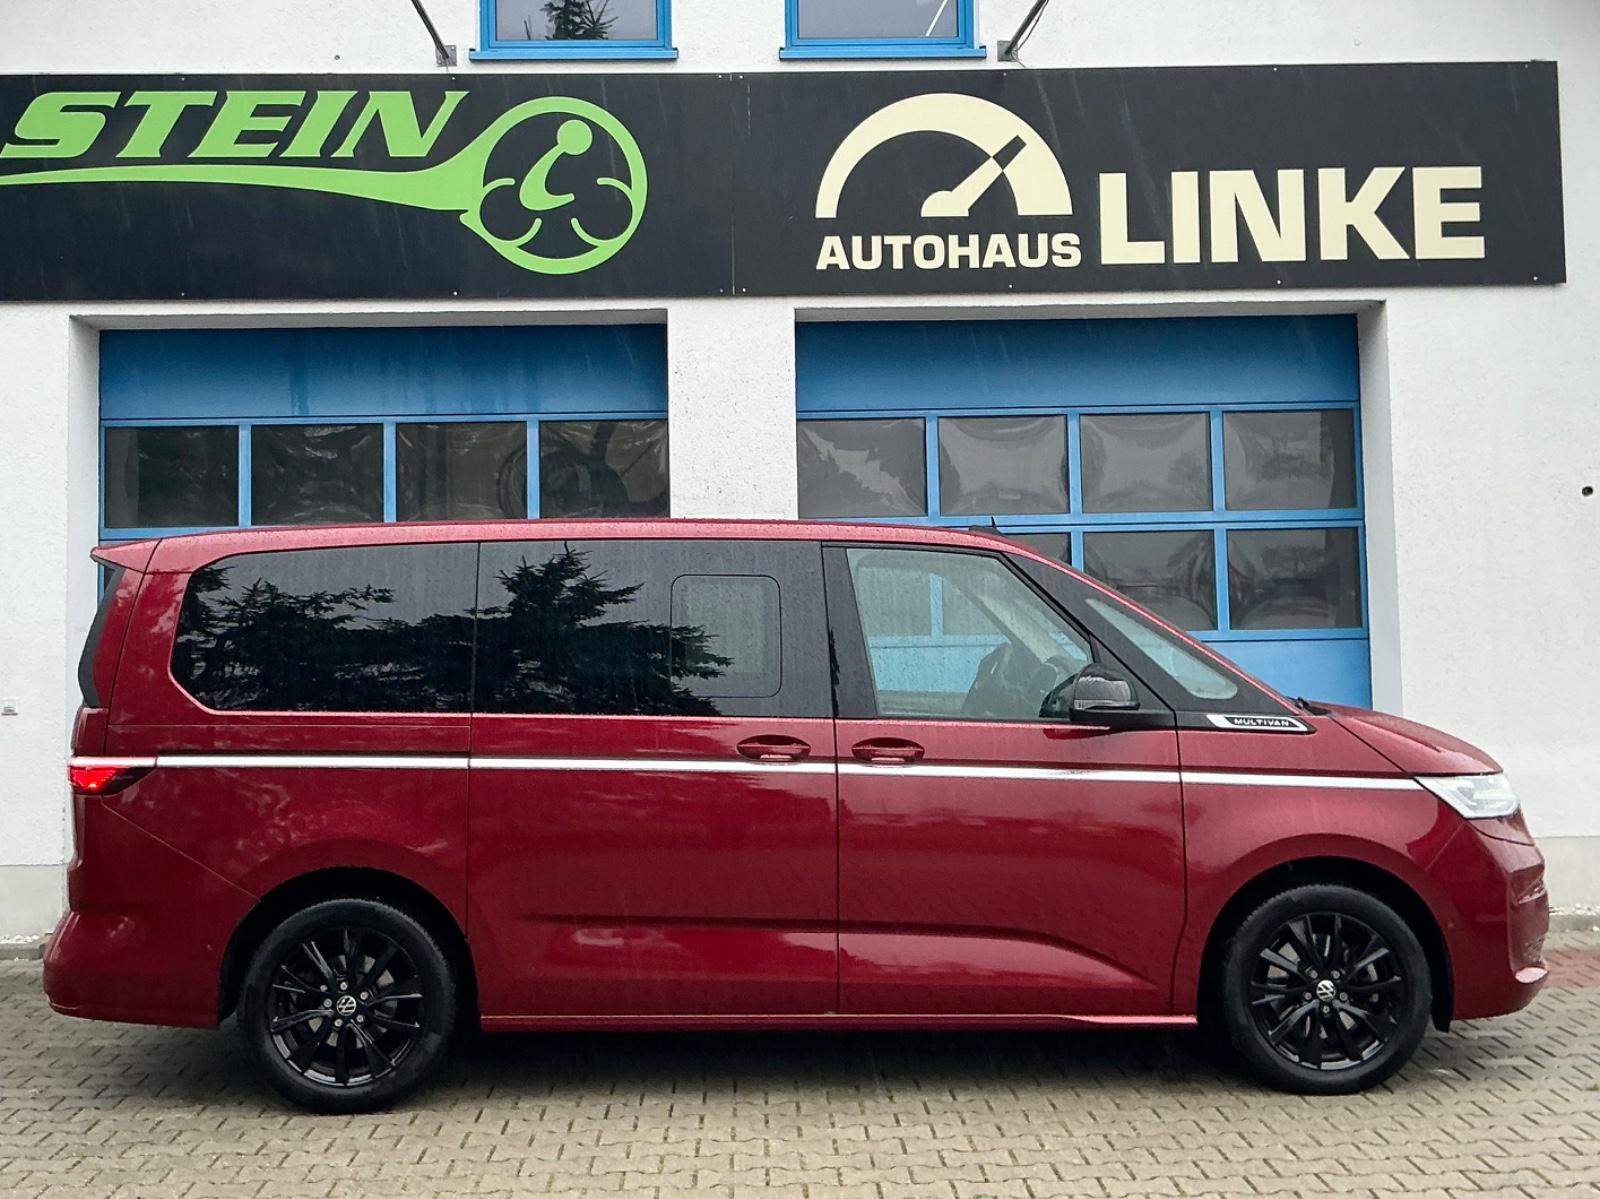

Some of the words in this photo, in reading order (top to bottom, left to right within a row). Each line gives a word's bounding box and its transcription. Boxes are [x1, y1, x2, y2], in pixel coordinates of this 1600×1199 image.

[0, 90, 470, 158] STEIN
[816, 232, 1081, 271] AUTOHAUS
[1099, 166, 1486, 265] LINKE
[1233, 717, 1290, 727] MULTIVAN
